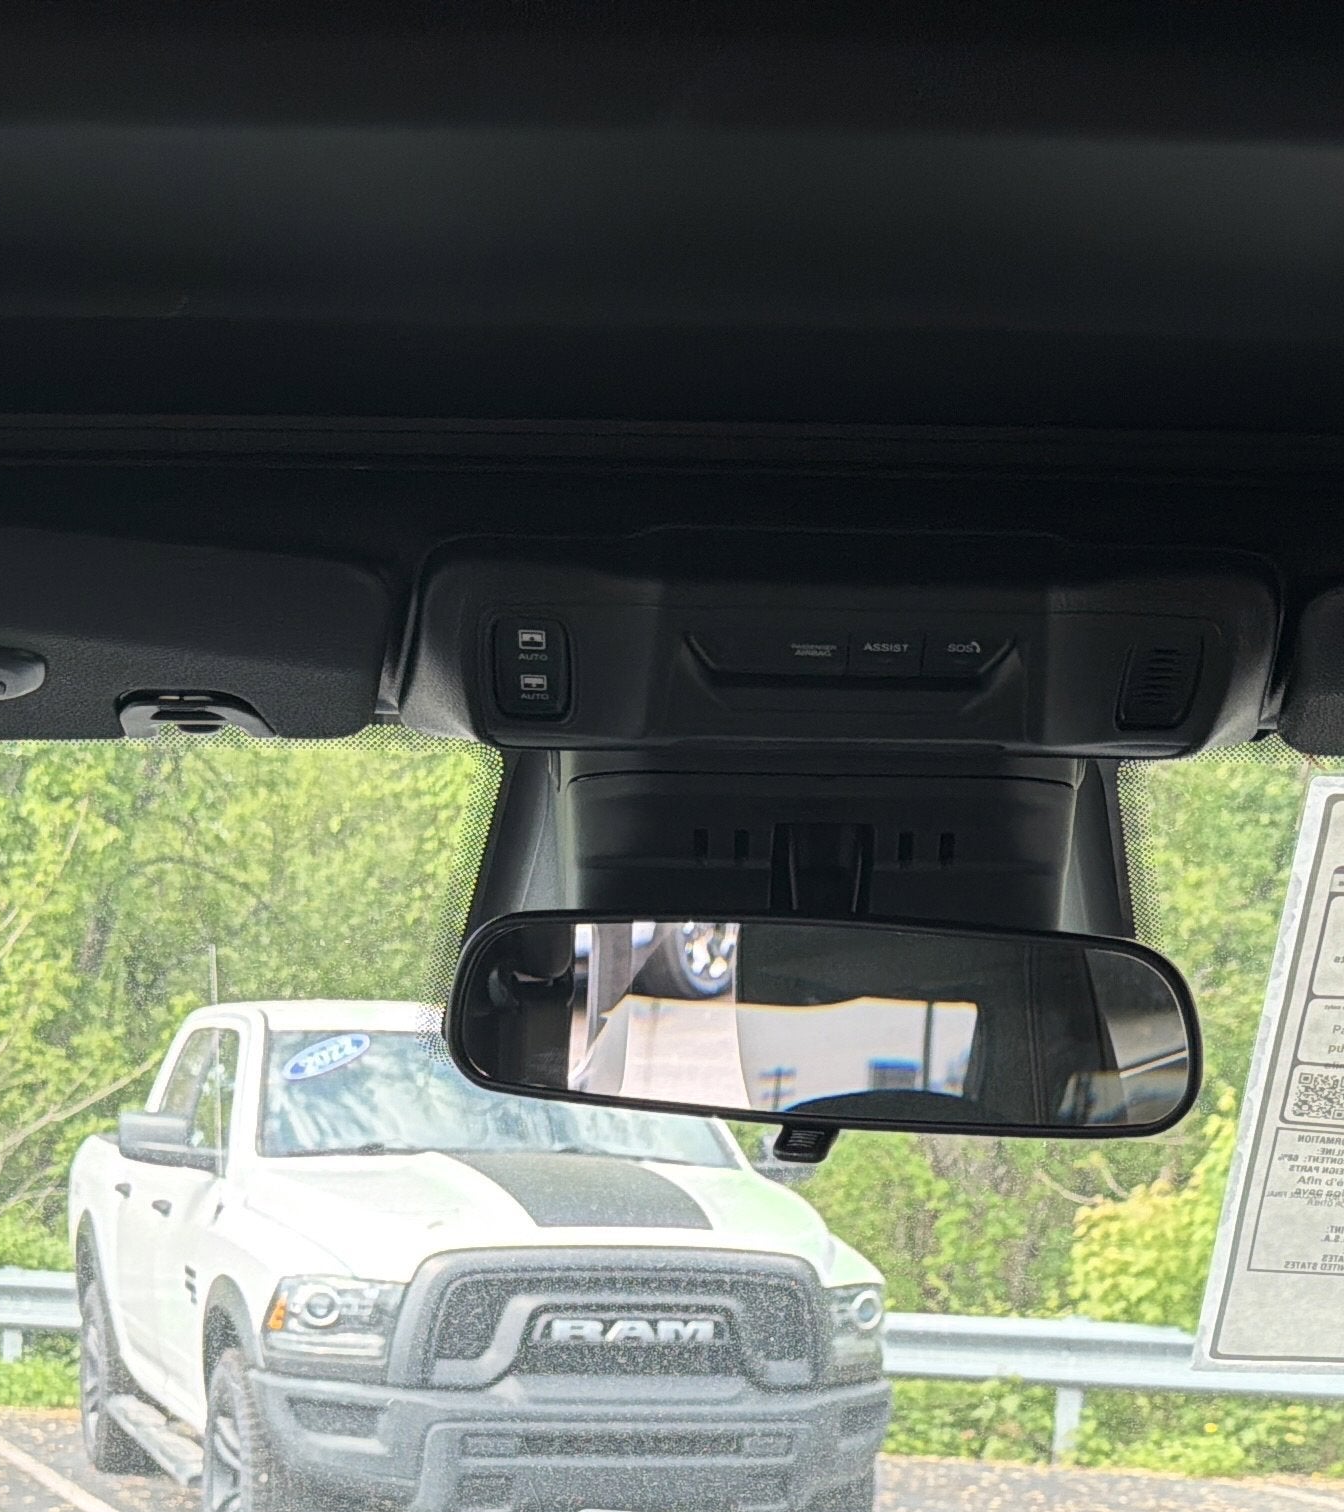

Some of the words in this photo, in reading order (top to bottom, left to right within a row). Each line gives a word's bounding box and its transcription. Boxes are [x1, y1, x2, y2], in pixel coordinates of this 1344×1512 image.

[864, 643, 909, 652] ASSIST
[948, 644, 973, 653] SOS
[303, 1037, 355, 1069] 2022
[551, 1319, 714, 1343] RAM
